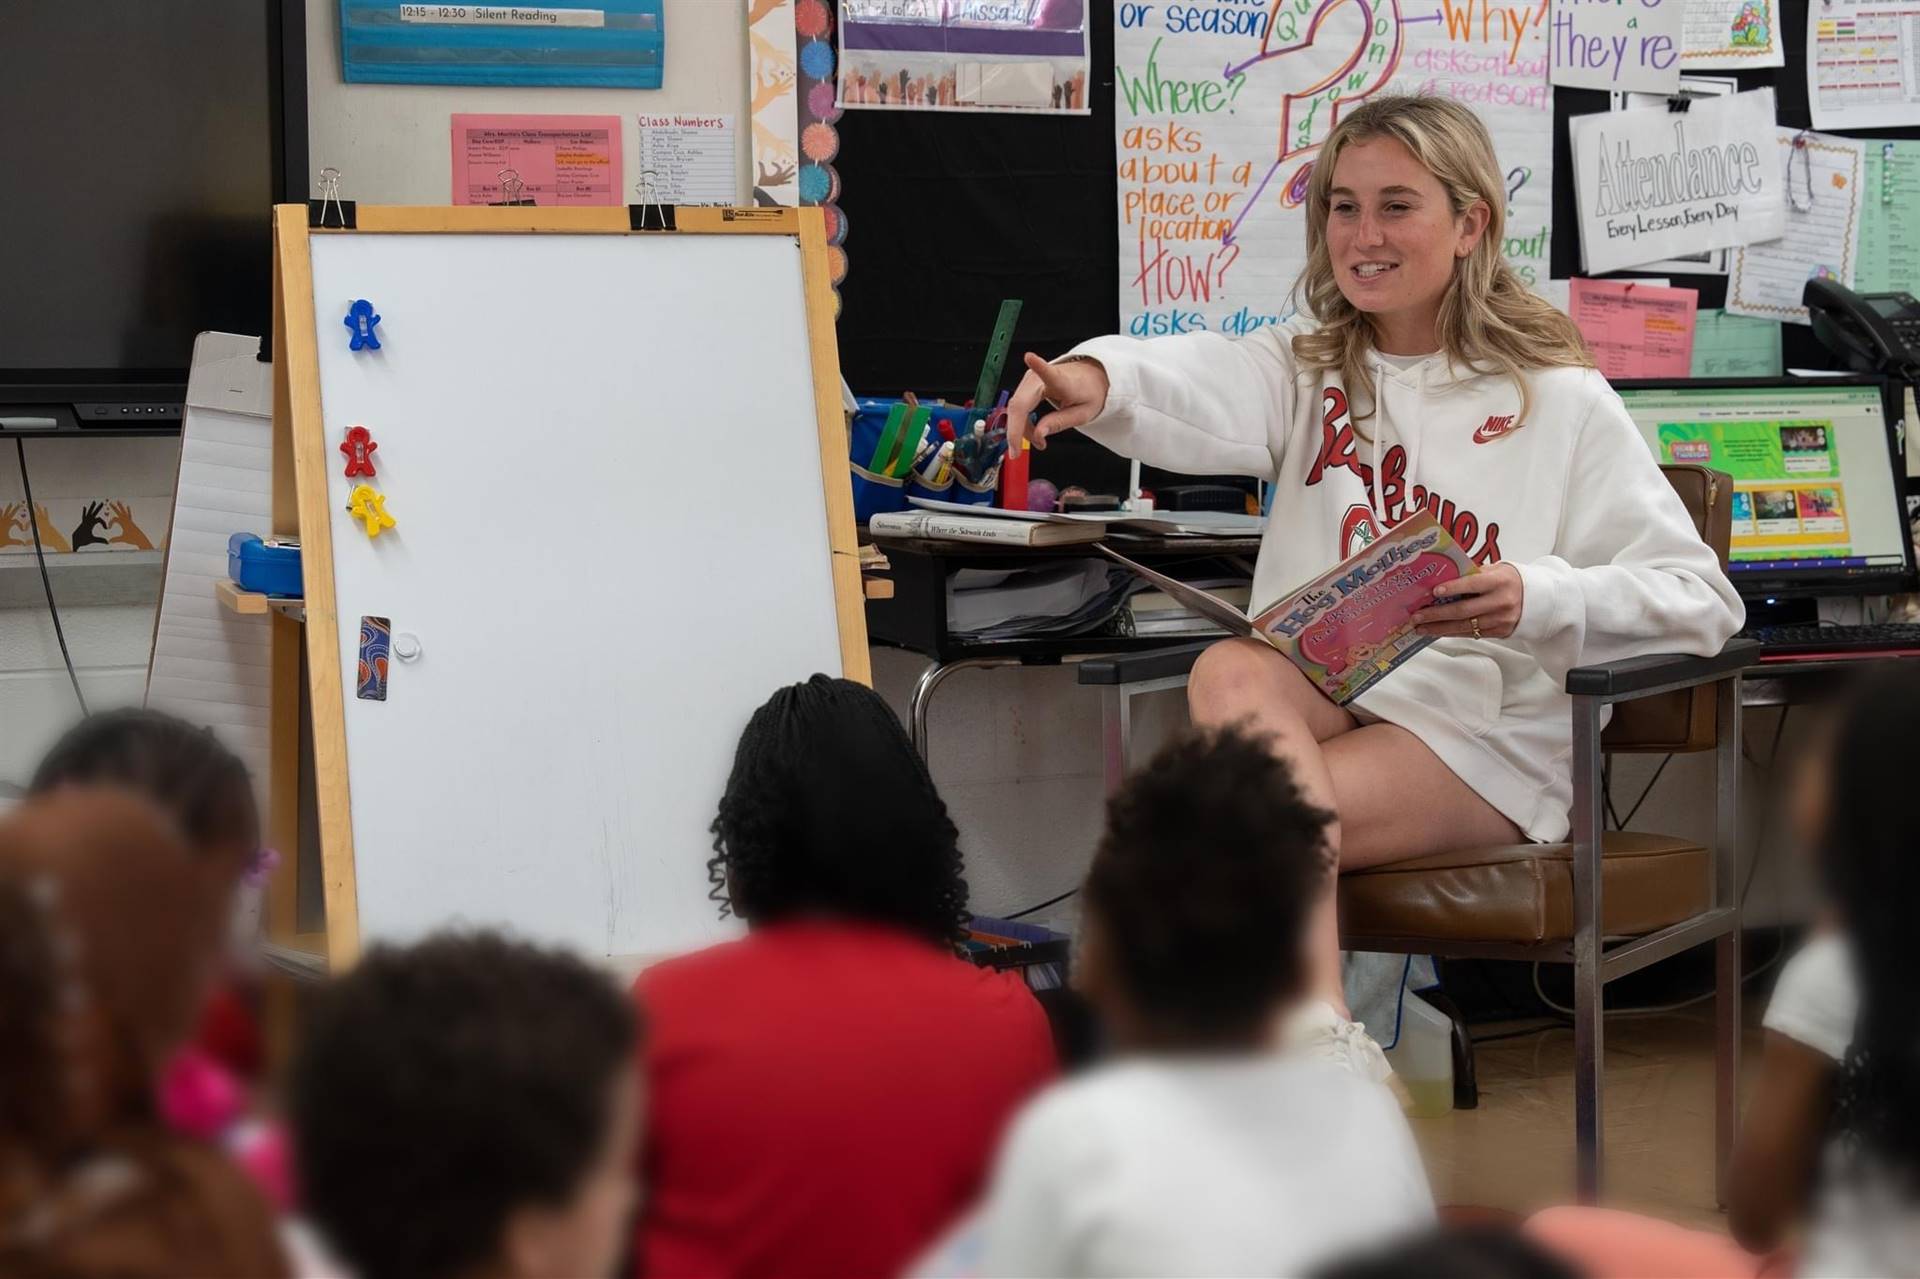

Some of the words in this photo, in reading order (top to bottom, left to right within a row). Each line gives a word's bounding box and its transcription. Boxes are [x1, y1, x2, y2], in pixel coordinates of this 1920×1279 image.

[403, 6, 426, 17] 12:15
[438, 7, 466, 18] 12:30
[475, 8, 507, 20] Silent
[511, 10, 557, 23] Reading
[1120, 3, 1154, 28] or
[1166, 5, 1268, 39] season
[1116, 37, 1246, 116] Where?
[1414, 48, 1480, 75] asks
[1451, 82, 1547, 111] reason
[640, 116, 670, 127] Class
[674, 116, 724, 128] Numbers
[1123, 121, 1201, 153] asks
[1120, 153, 1224, 185] about
[1232, 162, 1252, 187] a
[1595, 120, 1762, 218] Attendance
[1125, 188, 1195, 224] place
[1204, 191, 1243, 212] or
[1606, 220, 1637, 241] Every
[1715, 202, 1739, 222] Day
[1140, 214, 1232, 242] location
[1503, 226, 1551, 258] out
[1130, 309, 1206, 336] asks
[1482, 414, 1515, 431] NIKE
[1270, 592, 1337, 638] Hog
[1331, 530, 1439, 599] Mollies
[1294, 588, 1327, 606] The
